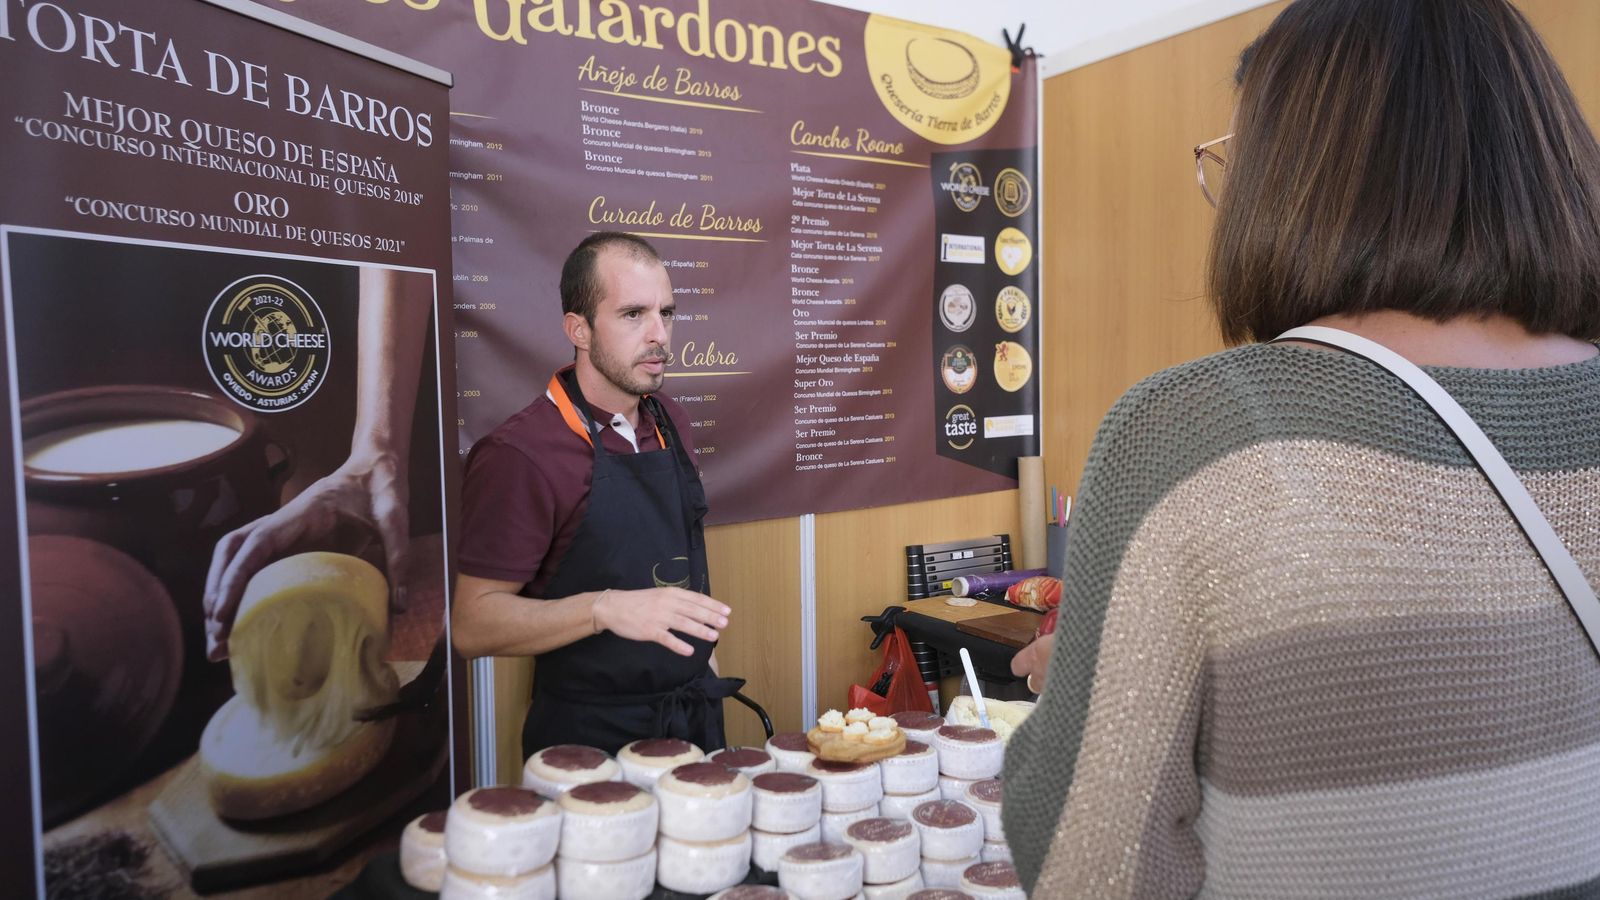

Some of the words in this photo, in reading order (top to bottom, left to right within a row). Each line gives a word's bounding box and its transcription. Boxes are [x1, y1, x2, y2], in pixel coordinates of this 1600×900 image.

[473, 0, 843, 78] Galardones
[578, 55, 637, 93] Añejo
[642, 65, 668, 92] de
[674, 68, 742, 102] Barros
[204, 49, 271, 109] DE
[283, 72, 434, 148] BARROS
[580, 100, 620, 115] Bronce
[581, 114, 599, 123] World
[600, 117, 622, 126] Cheese
[960, 117, 973, 132] de
[582, 124, 621, 138] Bronce
[790, 120, 852, 149] Cancho
[856, 128, 904, 155] Roano
[63, 91, 174, 139] MEJOR
[179, 117, 277, 160] QUESO
[283, 139, 314, 167] DE
[319, 146, 400, 185] ESPAÑA
[450, 139, 483, 149] rmingham
[486, 142, 503, 150] 2012
[583, 138, 611, 147] Concurso
[643, 145, 663, 153] quesos
[664, 146, 696, 156] Birmingham
[584, 150, 623, 164] Bronce
[161, 142, 308, 187] INTERNACIONAL
[309, 172, 330, 191] DE
[334, 176, 391, 202] QUESOS
[585, 163, 613, 173] Concurso
[666, 171, 698, 181] Birmingham
[790, 162, 811, 173] Plata
[449, 171, 483, 180] rmingham
[487, 173, 503, 181] 2011
[792, 187, 815, 199] Mejor
[816, 189, 835, 199] Torta
[836, 191, 846, 200] de
[847, 192, 857, 201] La
[857, 193, 880, 204] Serena
[233, 190, 290, 220] ORO
[461, 204, 479, 212] 2010
[588, 195, 665, 226] Curado
[669, 202, 694, 229] de
[699, 204, 763, 233] Barros
[802, 215, 829, 227] Premio
[199, 211, 282, 240] MUNDIAL
[285, 225, 307, 242] DE
[309, 228, 372, 252] QUESOS
[459, 236, 483, 244] Palmas
[791, 240, 814, 251] Mejor
[815, 241, 835, 251] Torta
[836, 243, 845, 251] de
[846, 243, 856, 252] La
[857, 244, 883, 253] Serena
[671, 260, 695, 269] (España)
[791, 264, 819, 274] Bronce
[791, 287, 820, 297] Bronce
[253, 295, 284, 307] 2021-22
[676, 314, 693, 322] (Italia)
[792, 308, 810, 317] Oro
[210, 331, 273, 348] WORLD
[275, 333, 325, 349] CHEESE
[795, 331, 810, 340] 3er
[811, 331, 838, 340] Premio
[666, 352, 676, 366] e
[681, 341, 739, 368] Cabra
[796, 354, 818, 366] Mejor
[819, 354, 842, 365] Queso
[842, 353, 853, 362] de
[854, 353, 880, 364] España
[246, 367, 298, 387] AWARDS
[794, 379, 816, 389] Super
[818, 378, 834, 387] Oro
[223, 373, 253, 401] OVIEDO
[257, 392, 299, 407] ASTURIAS
[300, 369, 320, 395] SPAIN
[679, 395, 703, 403] (Francia)
[794, 405, 807, 414] 3er
[809, 403, 837, 413] Premio
[952, 412, 970, 424] great
[795, 429, 808, 439] 3er
[810, 427, 836, 437] Premio
[945, 421, 977, 437] taste
[796, 452, 823, 462] Bronce
